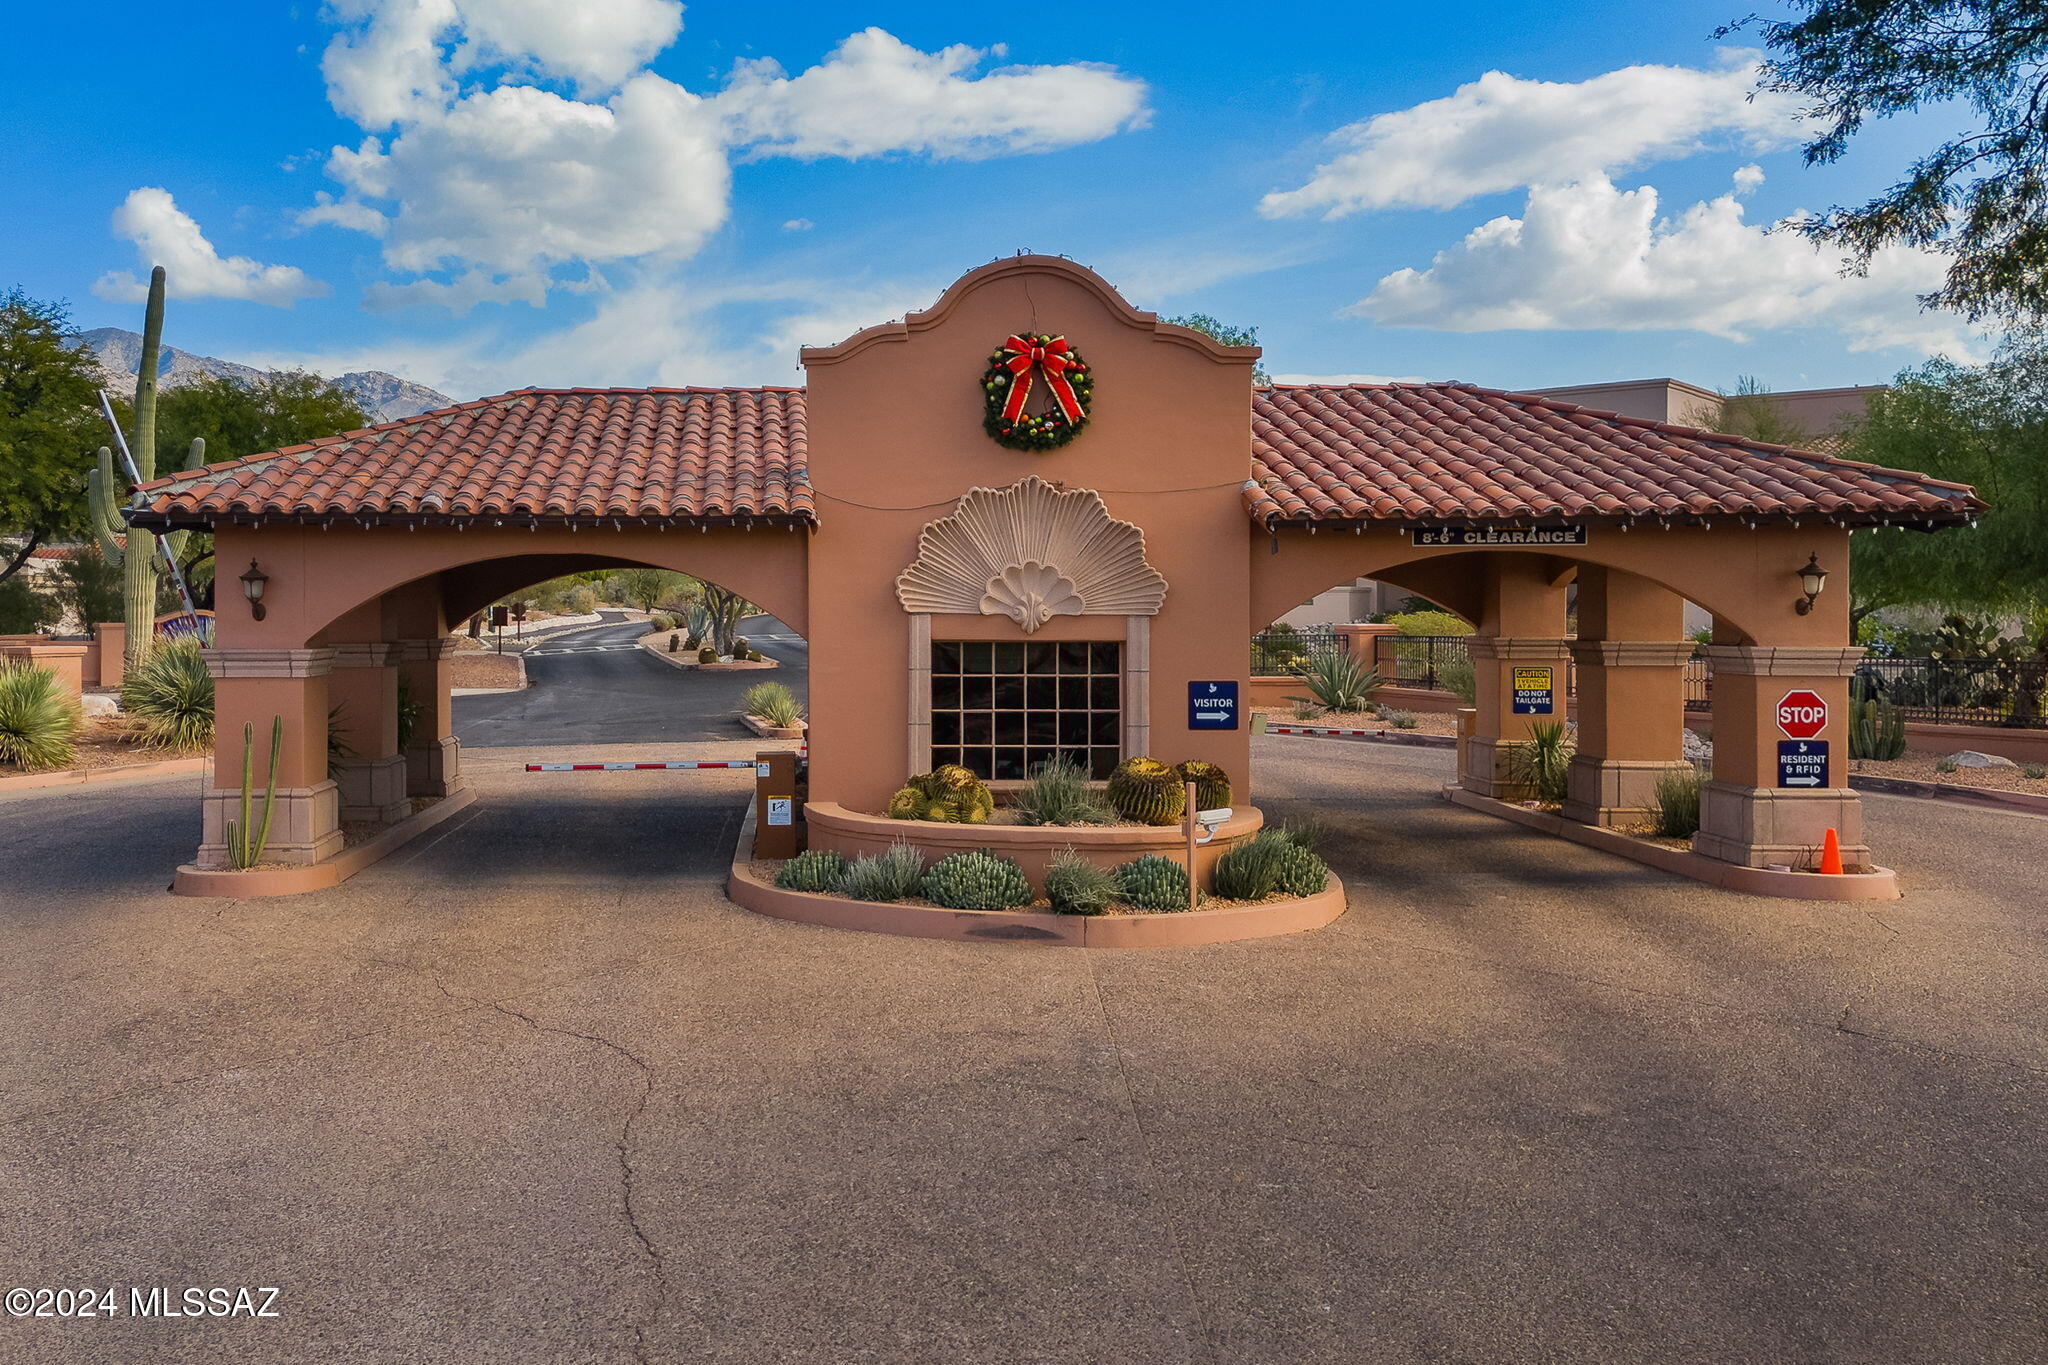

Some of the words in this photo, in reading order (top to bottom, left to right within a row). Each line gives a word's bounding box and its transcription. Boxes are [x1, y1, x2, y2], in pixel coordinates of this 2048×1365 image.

[1464, 531, 1576, 543] CLEARANCE
[1517, 670, 1549, 678] CAUTION
[1194, 698, 1233, 707] VISITOR
[1780, 706, 1824, 723] STOP
[1780, 755, 1826, 764] RESIDENT
[1786, 765, 1793, 773] &
[1796, 765, 1820, 773] RFID
